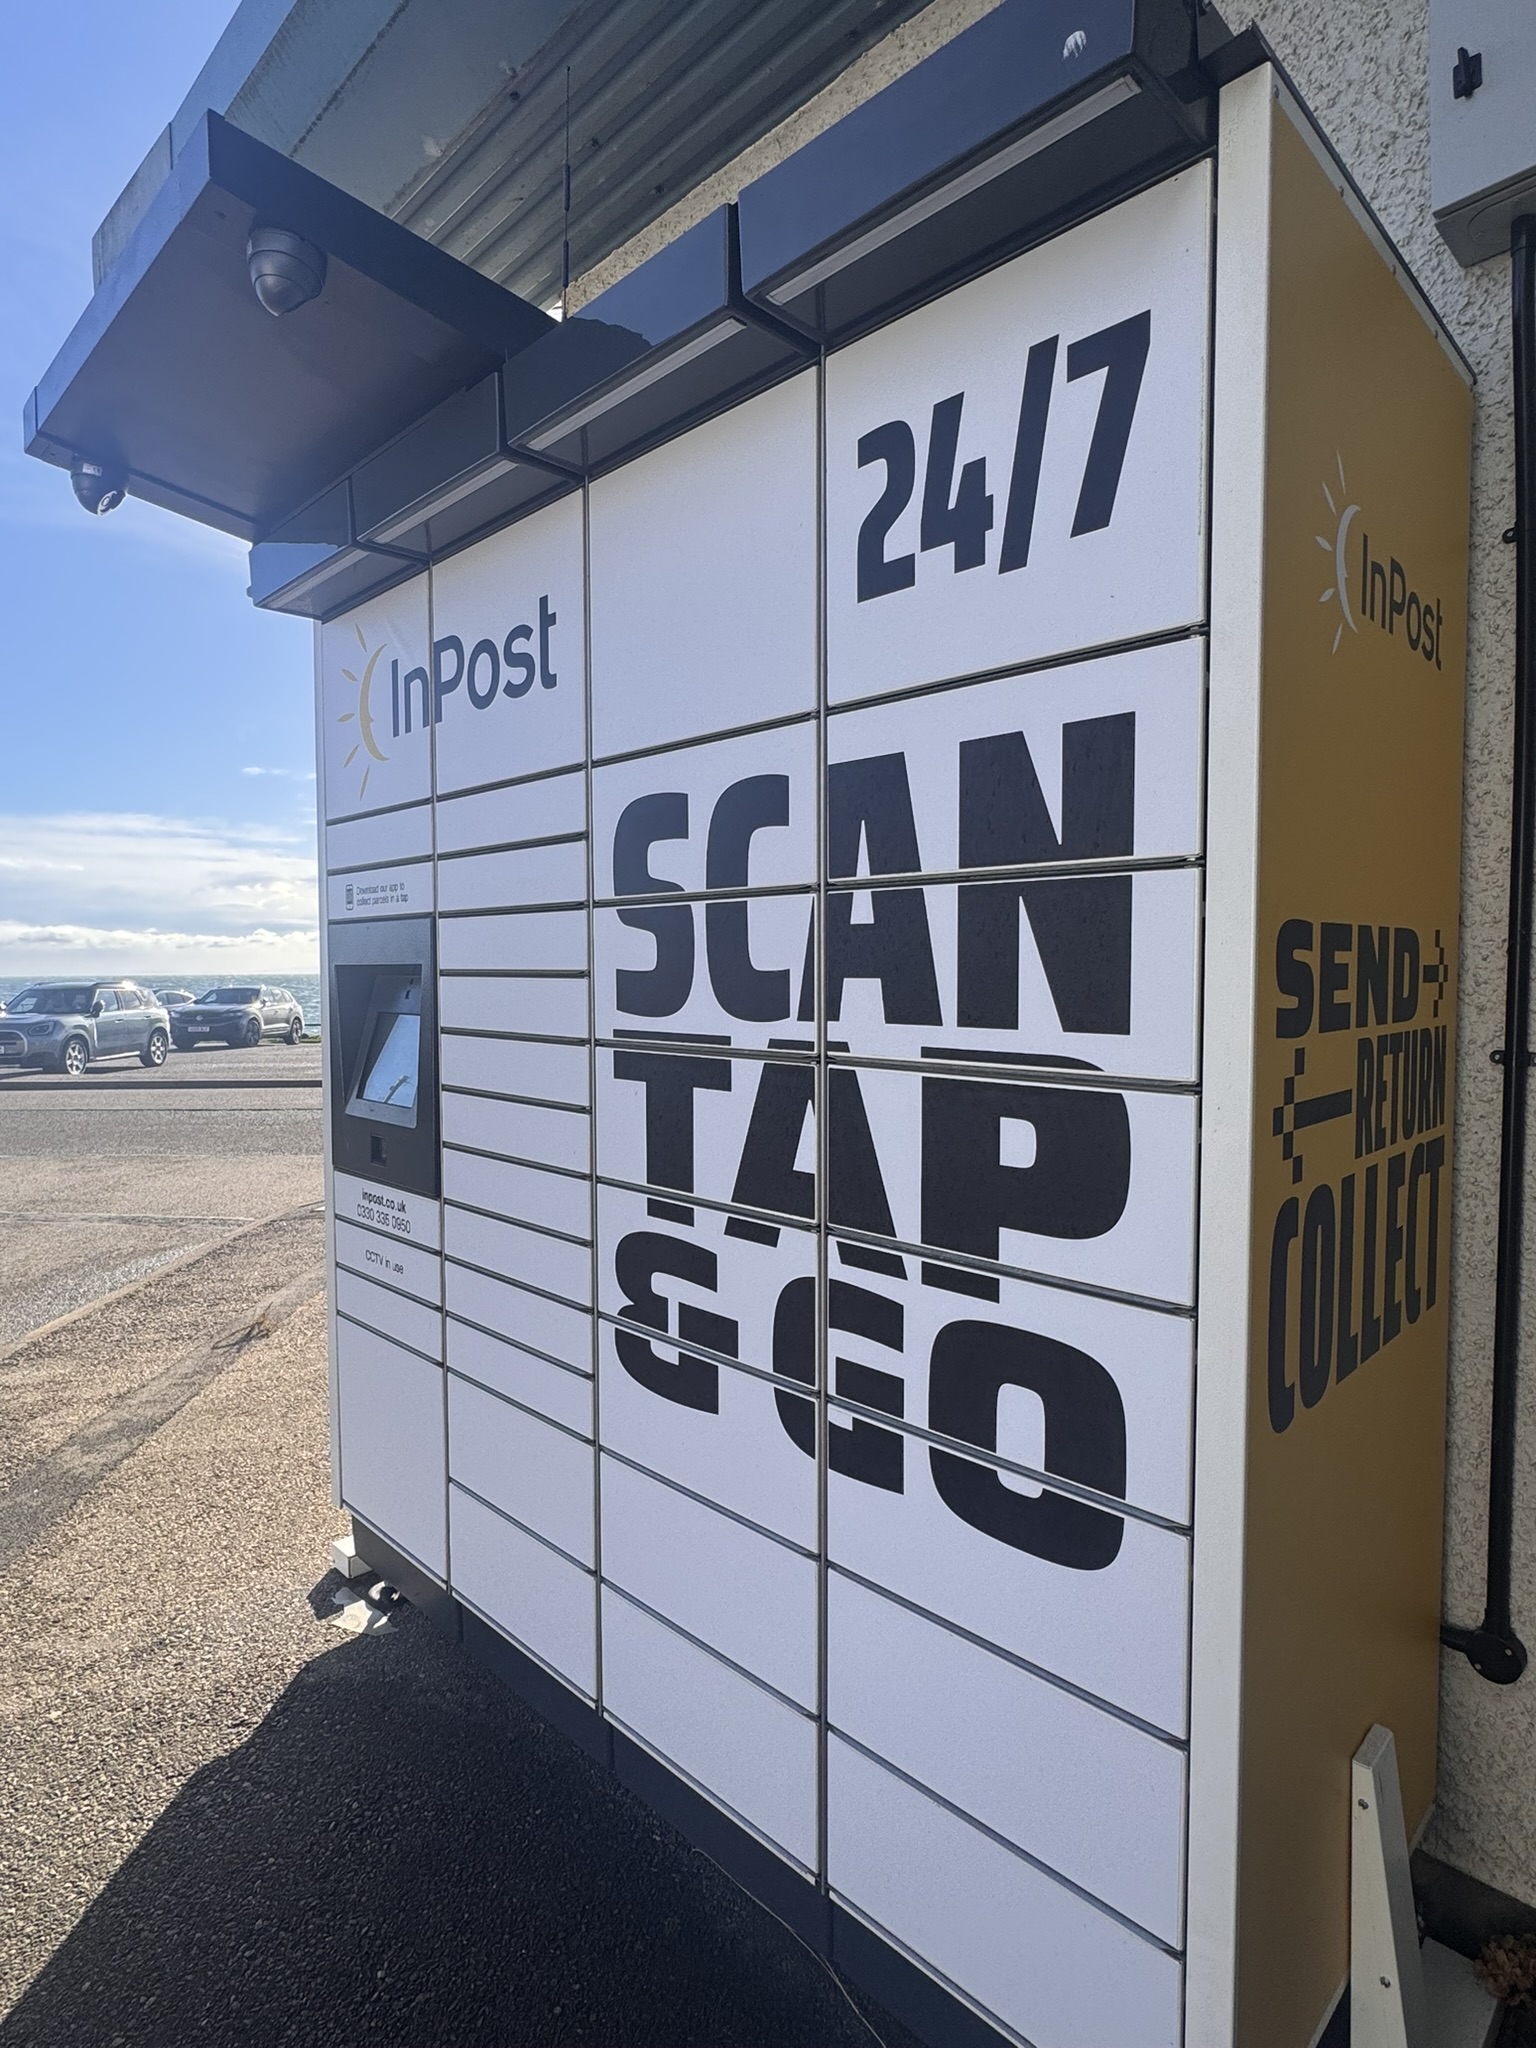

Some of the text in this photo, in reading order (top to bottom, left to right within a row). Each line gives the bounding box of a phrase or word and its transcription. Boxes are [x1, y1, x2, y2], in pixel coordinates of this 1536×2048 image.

[857, 309, 1151, 604] 24/7
[391, 594, 558, 738] InPost
[1361, 532, 1444, 671] InPost
[612, 711, 1136, 1036] SCAN
[1276, 919, 1420, 1039] SEND
[1355, 1025, 1447, 1160] RETURN
[356, 1203, 411, 1234] 0330 335 0950
[362, 1188, 406, 1214] inpost.co.uk
[613, 1029, 1131, 1304] TAP
[365, 1249, 404, 1275] CCTV in use
[1268, 1135, 1445, 1434] COLLECT
[614, 1231, 1127, 1571] & GO
